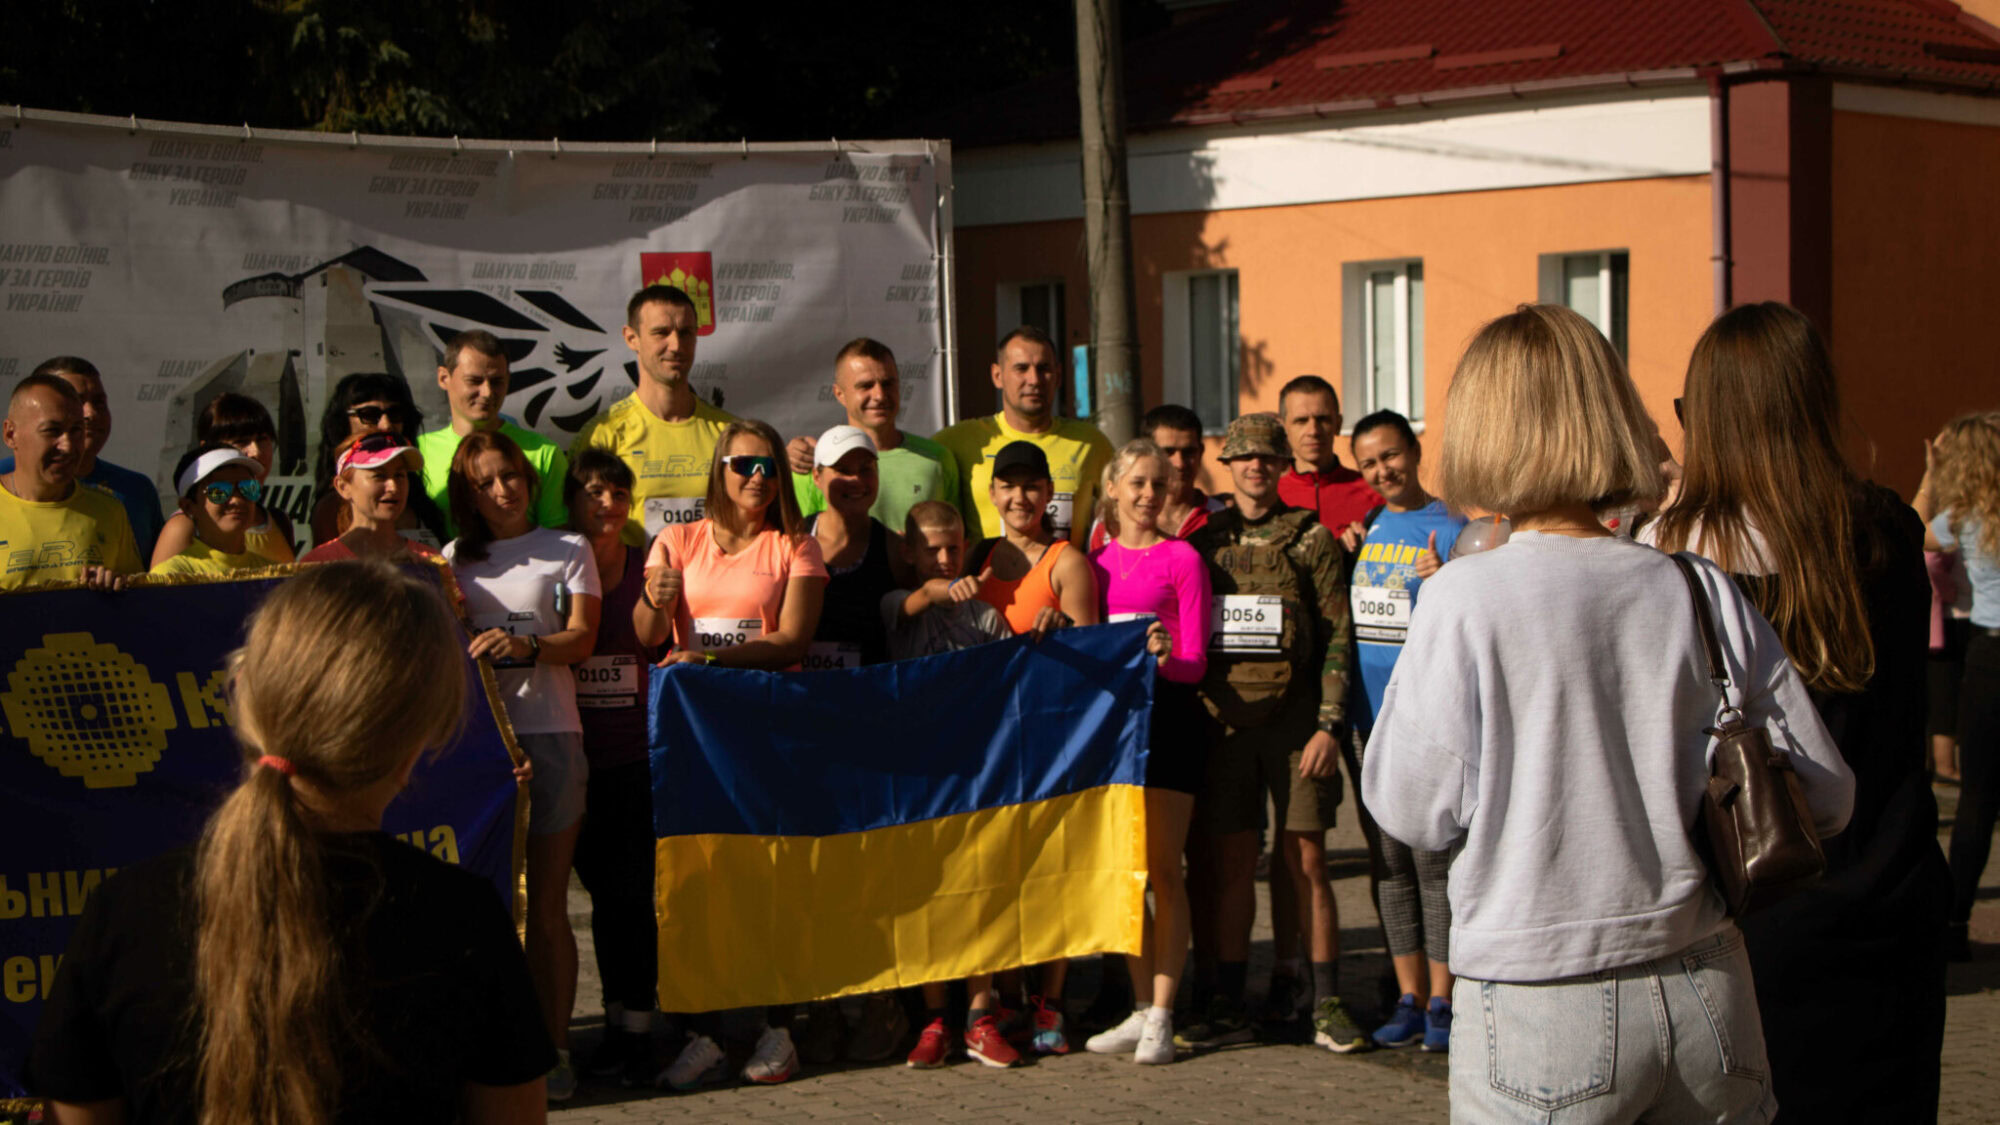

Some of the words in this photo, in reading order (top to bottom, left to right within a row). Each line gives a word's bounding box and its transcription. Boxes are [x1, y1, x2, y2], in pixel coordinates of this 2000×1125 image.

[9, 269, 32, 287] ЗА
[33, 267, 92, 288] ГЕРОЇВ
[663, 509, 704, 524] 0105
[1221, 608, 1265, 622] 0056
[1359, 600, 1396, 617] 0080
[701, 632, 746, 647] 0099
[800, 655, 844, 669] 0064
[578, 668, 621, 682] 0103
[0, 867, 119, 920] ьни
